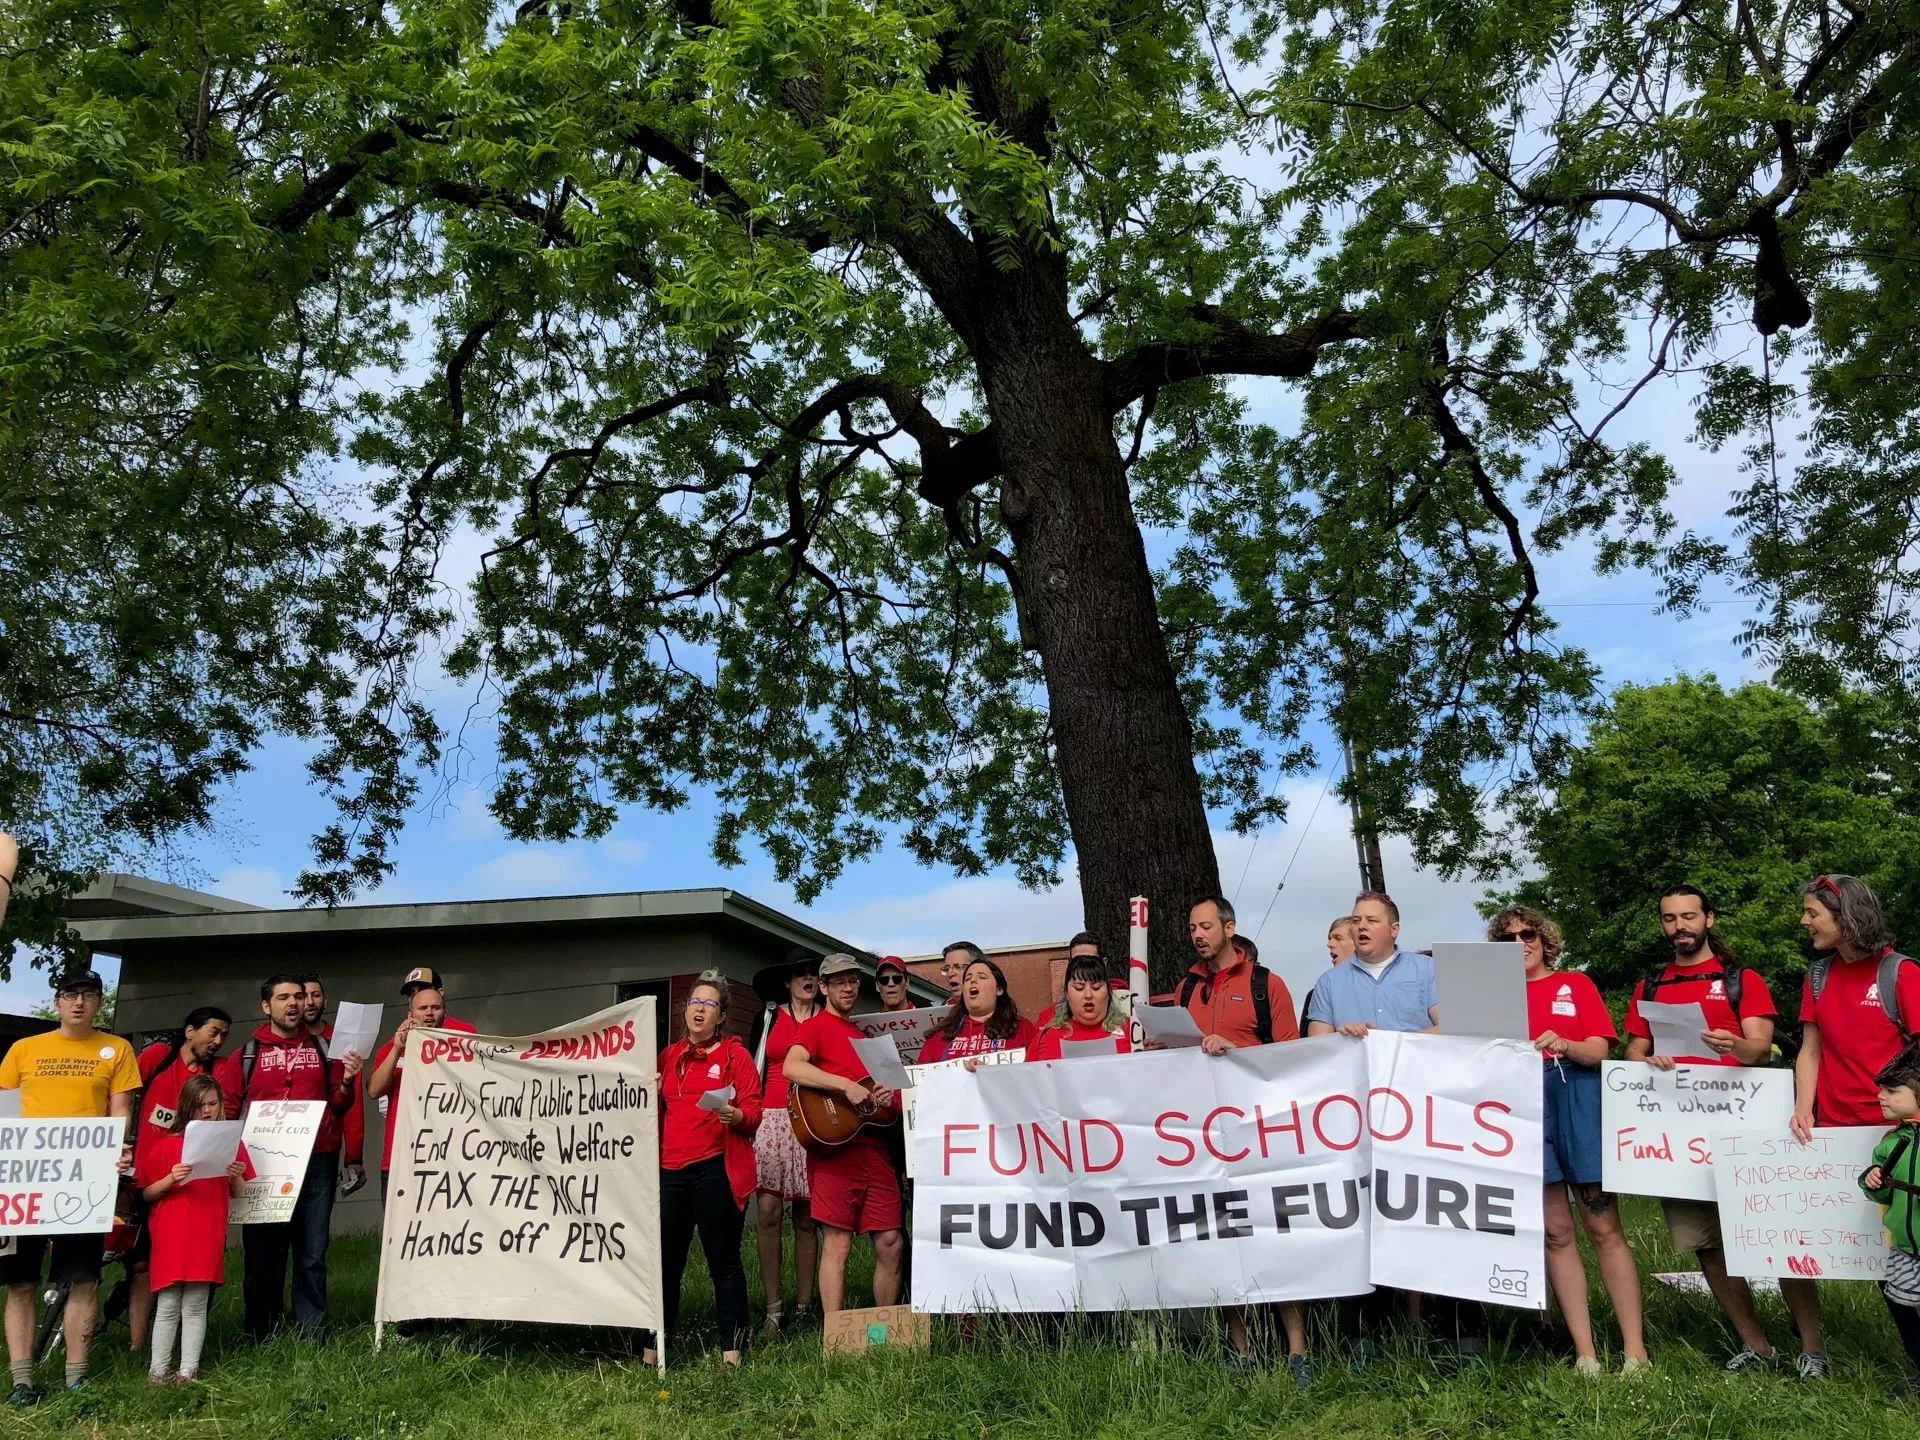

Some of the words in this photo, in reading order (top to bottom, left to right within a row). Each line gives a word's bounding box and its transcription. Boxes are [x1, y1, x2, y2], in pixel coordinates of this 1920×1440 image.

[519, 1020, 635, 1061] DEMANDS
[73, 1058, 101, 1066] WHAT
[1607, 1067, 1656, 1092] Good
[424, 1081, 476, 1123] Fully
[480, 1081, 525, 1121] Fund
[530, 1077, 573, 1121] Public
[578, 1072, 648, 1115] Education
[1637, 1094, 1662, 1113] for
[34, 1126, 116, 1149] SCHOOL
[253, 1126, 283, 1134] BUDGET
[286, 1126, 310, 1134] CUTS
[944, 1118, 1124, 1176] FUND
[1154, 1087, 1514, 1167] SCHOOLS
[414, 1128, 453, 1164] End
[462, 1128, 545, 1167] Corporate
[557, 1121, 634, 1165] Welfare
[1617, 1127, 1674, 1162] Fund
[1720, 1136, 1748, 1157] I
[68, 1158, 83, 1182] A
[1734, 1163, 1869, 1187] KINDERGARTE
[414, 1171, 476, 1213] TAX
[490, 1174, 540, 1210] THE
[547, 1174, 599, 1216] RICH
[1744, 1192, 1793, 1216] NEXT
[940, 1200, 1106, 1249] FUND
[1120, 1189, 1254, 1246] THE
[401, 1219, 483, 1260] Hands
[499, 1221, 549, 1253] off
[560, 1222, 626, 1262] PERS
[1734, 1223, 1778, 1252] HELP
[1784, 1228, 1813, 1246] ME
[1489, 1277, 1527, 1292] oea
